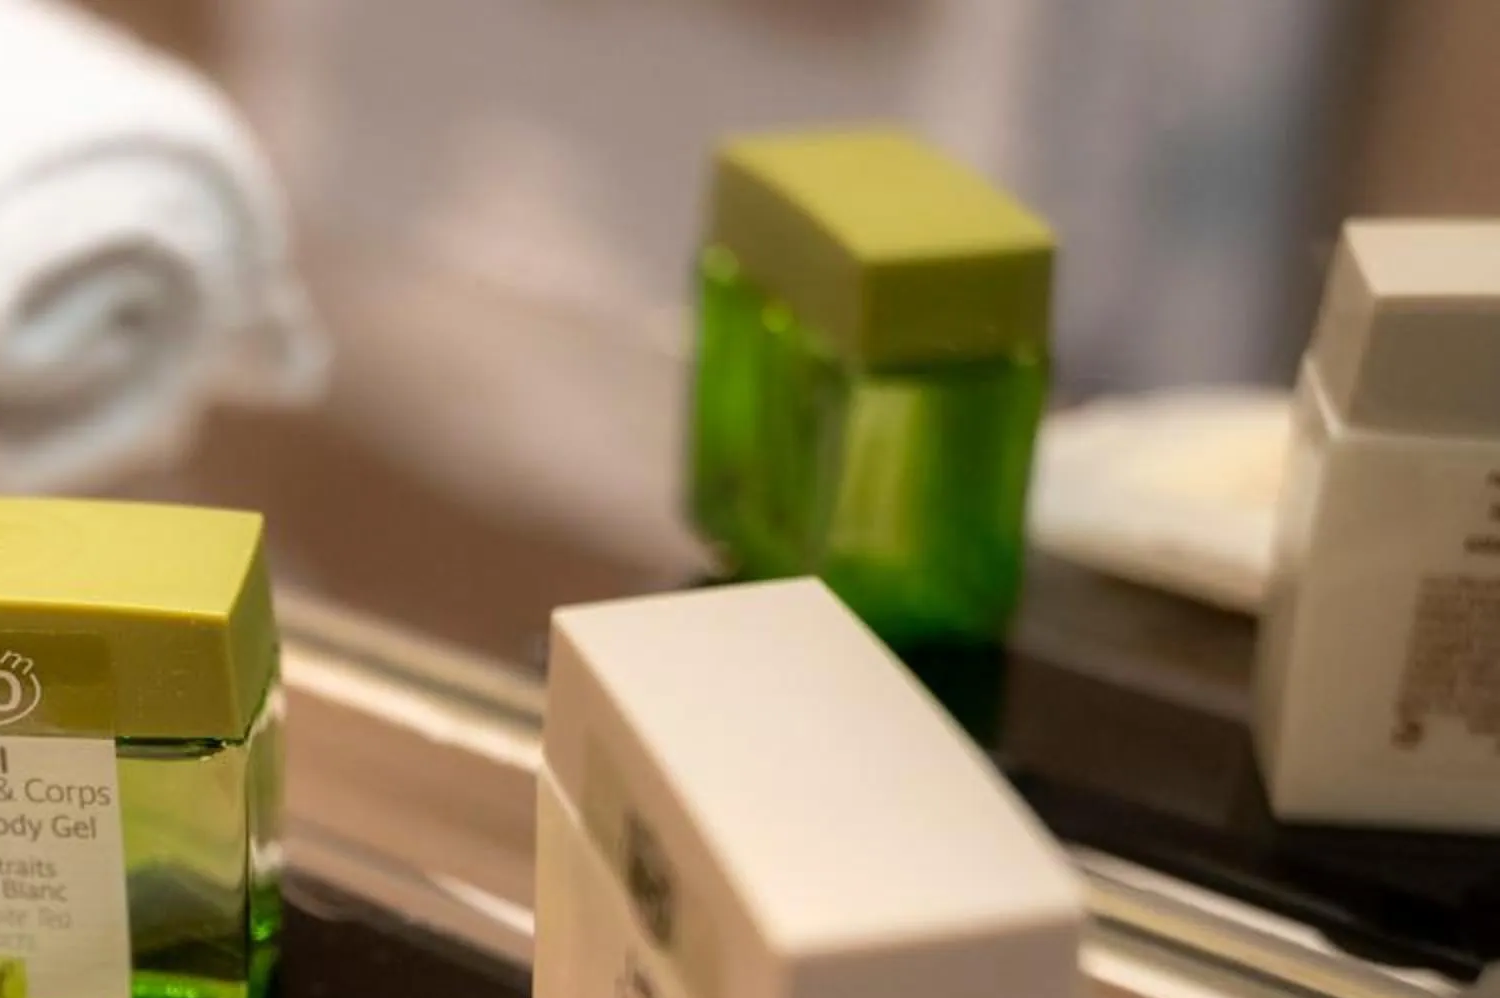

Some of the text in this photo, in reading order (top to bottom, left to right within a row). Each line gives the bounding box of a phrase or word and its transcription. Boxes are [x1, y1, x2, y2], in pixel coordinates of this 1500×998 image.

[24, 778, 112, 808] Corps
[51, 814, 98, 840] Gel
[2, 878, 68, 902] Blanc
